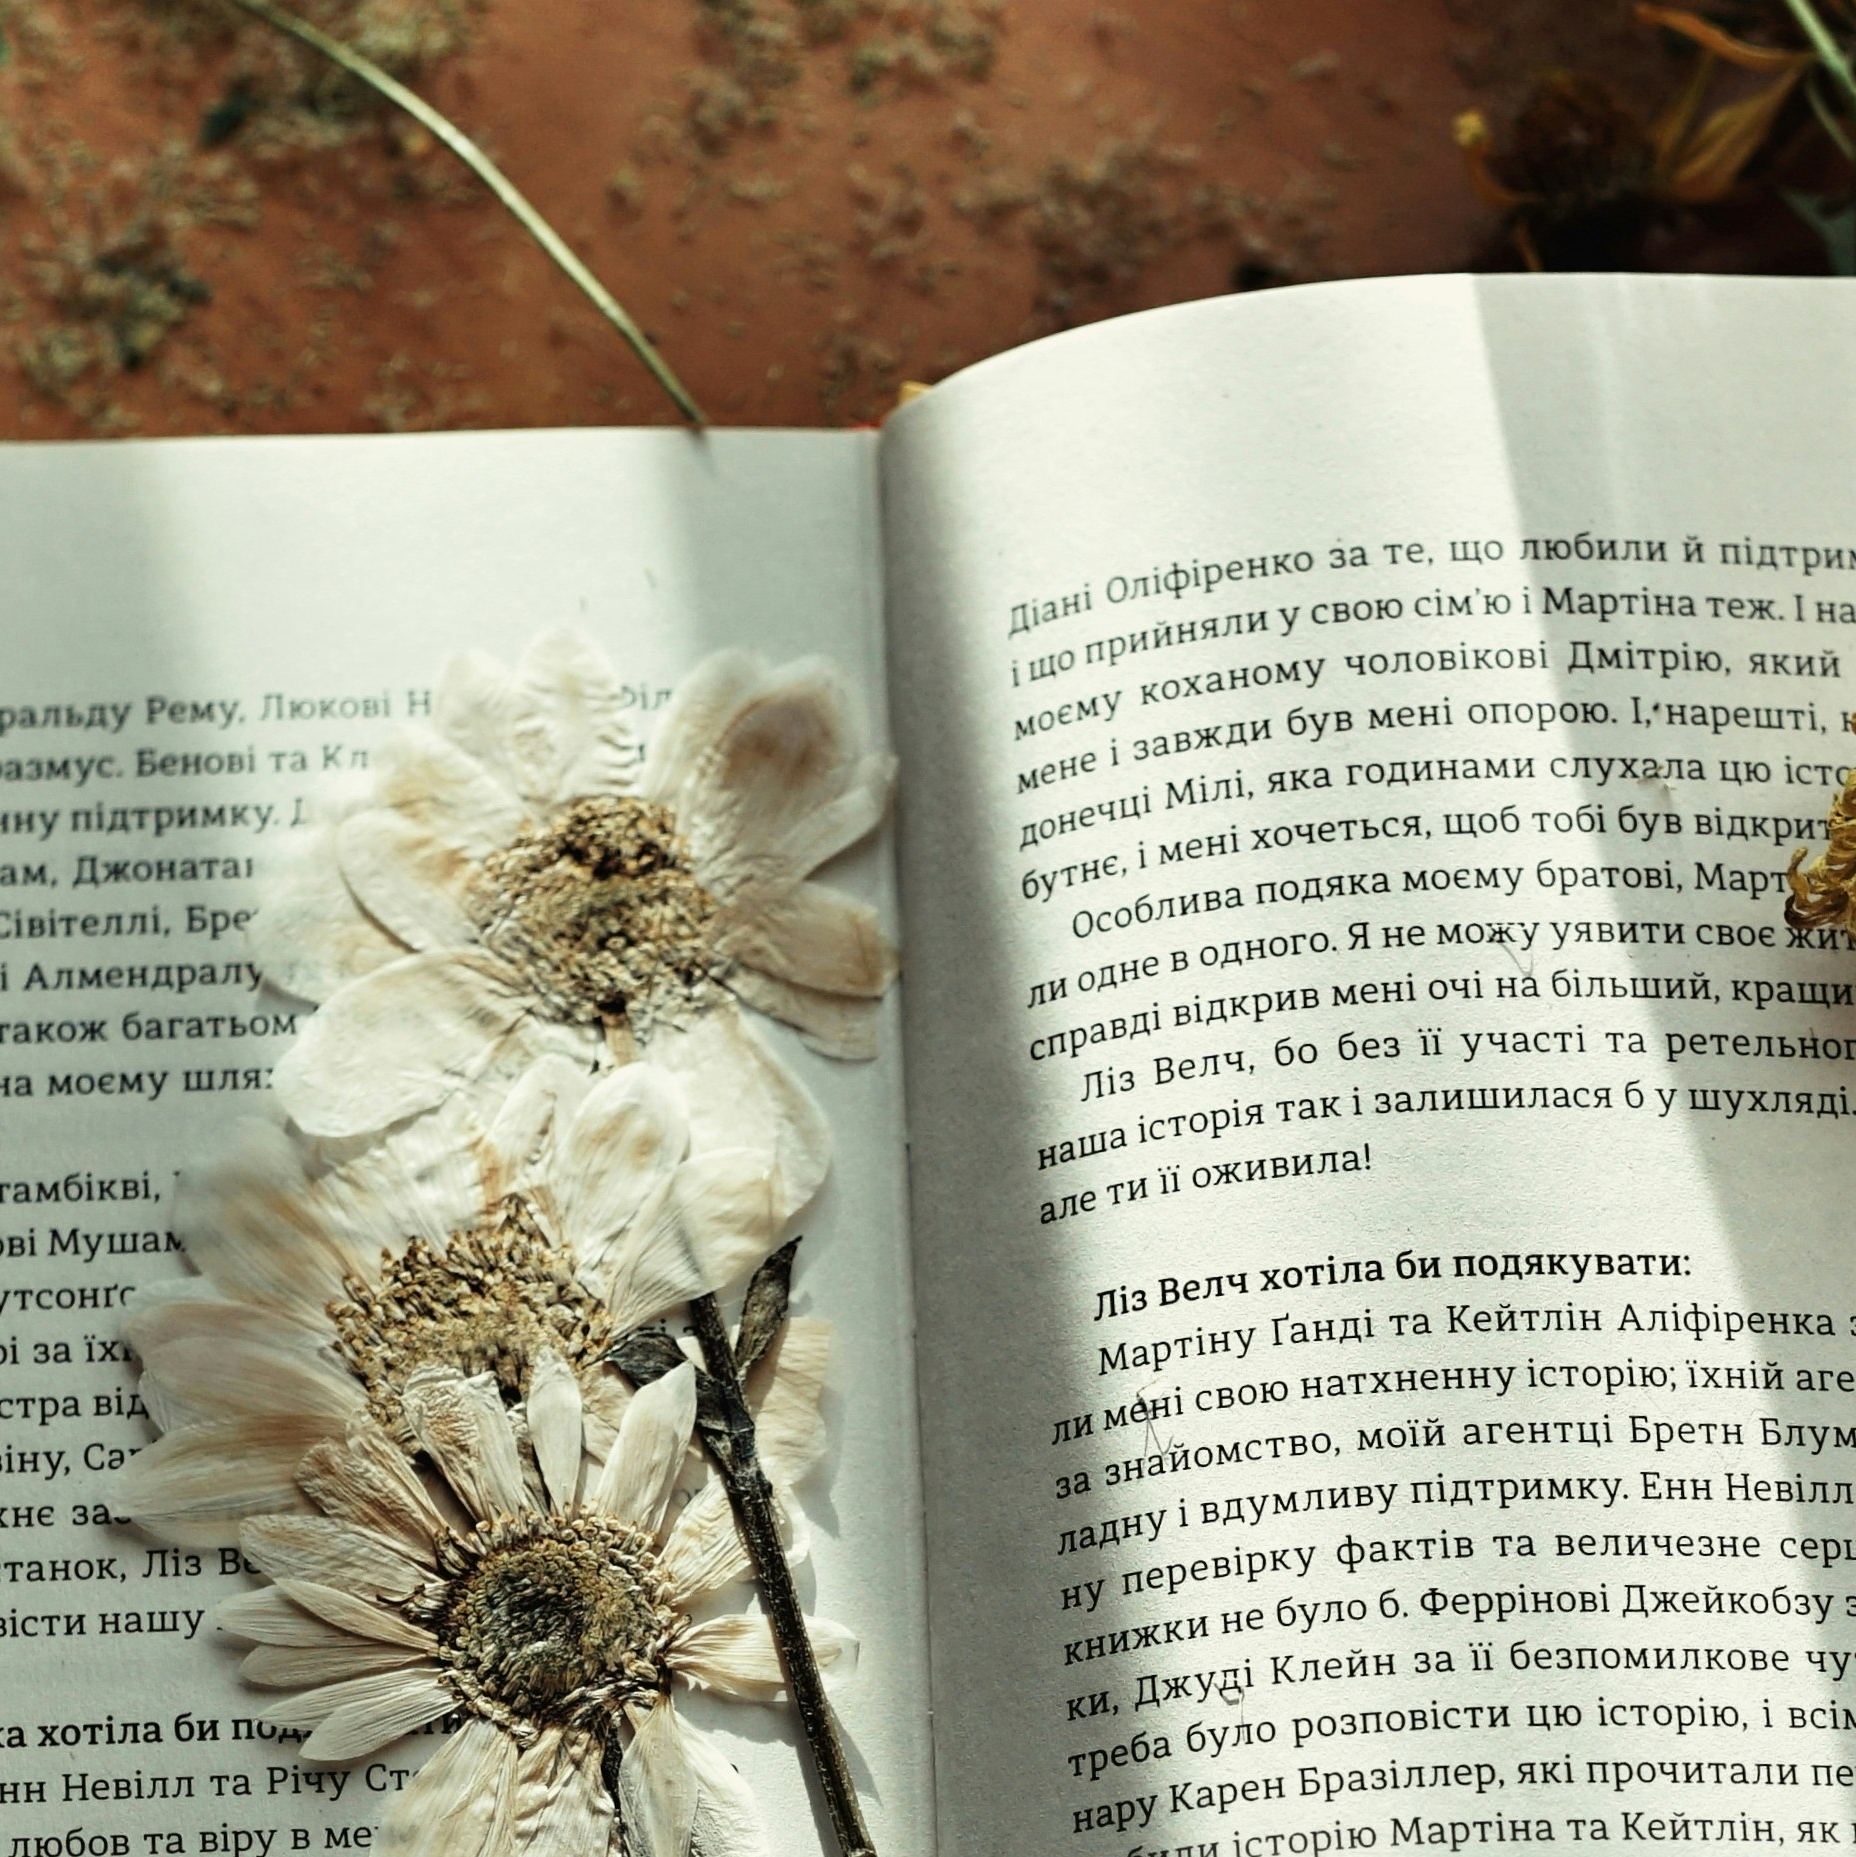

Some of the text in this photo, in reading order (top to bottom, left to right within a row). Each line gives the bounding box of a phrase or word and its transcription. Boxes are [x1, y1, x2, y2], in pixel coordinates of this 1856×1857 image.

[1008, 590, 1093, 638] Діані
[1105, 550, 1315, 604] Оліфіренко
[1328, 545, 1370, 570] за
[1382, 542, 1434, 566] те,
[1449, 539, 1504, 565] що
[1520, 530, 1669, 563] любили
[1682, 534, 1706, 564] й
[145, 695, 245, 731] Рему,
[262, 693, 390, 720] Люкові
[1014, 689, 1123, 742] моєму
[1140, 657, 1327, 706] коханому
[1343, 640, 1548, 677] чоловікові
[1566, 639, 1732, 680] Дмітрію,
[1748, 649, 1841, 679] який
[1019, 756, 1772, 852] донечці Мілі, яка годинами слухала цю
[1071, 858, 1684, 940] Особлива подяка моєму братові,
[1029, 1001, 1162, 1062] справді
[1172, 987, 1321, 1028] відкрив
[1331, 971, 1418, 1008] мені
[1427, 970, 1485, 1002] очі
[1494, 970, 1542, 999] на
[1550, 967, 1721, 1005] більший,
[1037, 1127, 1129, 1171] наша
[1137, 1098, 1266, 1144] історія
[1274, 1095, 1343, 1123] так
[1351, 1085, 1364, 1117] і
[1373, 1086, 1614, 1115] залишилася
[1623, 1078, 1645, 1110] б
[1654, 1087, 1678, 1119] у
[1039, 1142, 1372, 1226] але ти її оживила!
[1093, 1248, 1692, 1322] Ліз Велч хотіла би подякувати:
[1050, 1412, 1095, 1447] ли
[1103, 1385, 1185, 1432] мені
[1194, 1379, 1290, 1413] свою
[1299, 1365, 1518, 1400] натхненну
[1526, 1356, 1677, 1397] історію;
[1684, 1358, 1786, 1391] їхній
[97, 1609, 206, 1641] нашу
[36, 1713, 165, 1748] хотіла
[173, 1711, 221, 1744] би
[61, 1768, 196, 1803] Невілл
[208, 1773, 253, 1798] та
[265, 1765, 350, 1802] Річу
[142, 1831, 187, 1856] та
[289, 1827, 312, 1851] в
[1390, 1811, 1556, 1854] Мартіна
[1565, 1818, 1611, 1842] та
[1620, 1811, 1785, 1847] Кейтлін,
[1796, 1820, 1841, 1844] як
